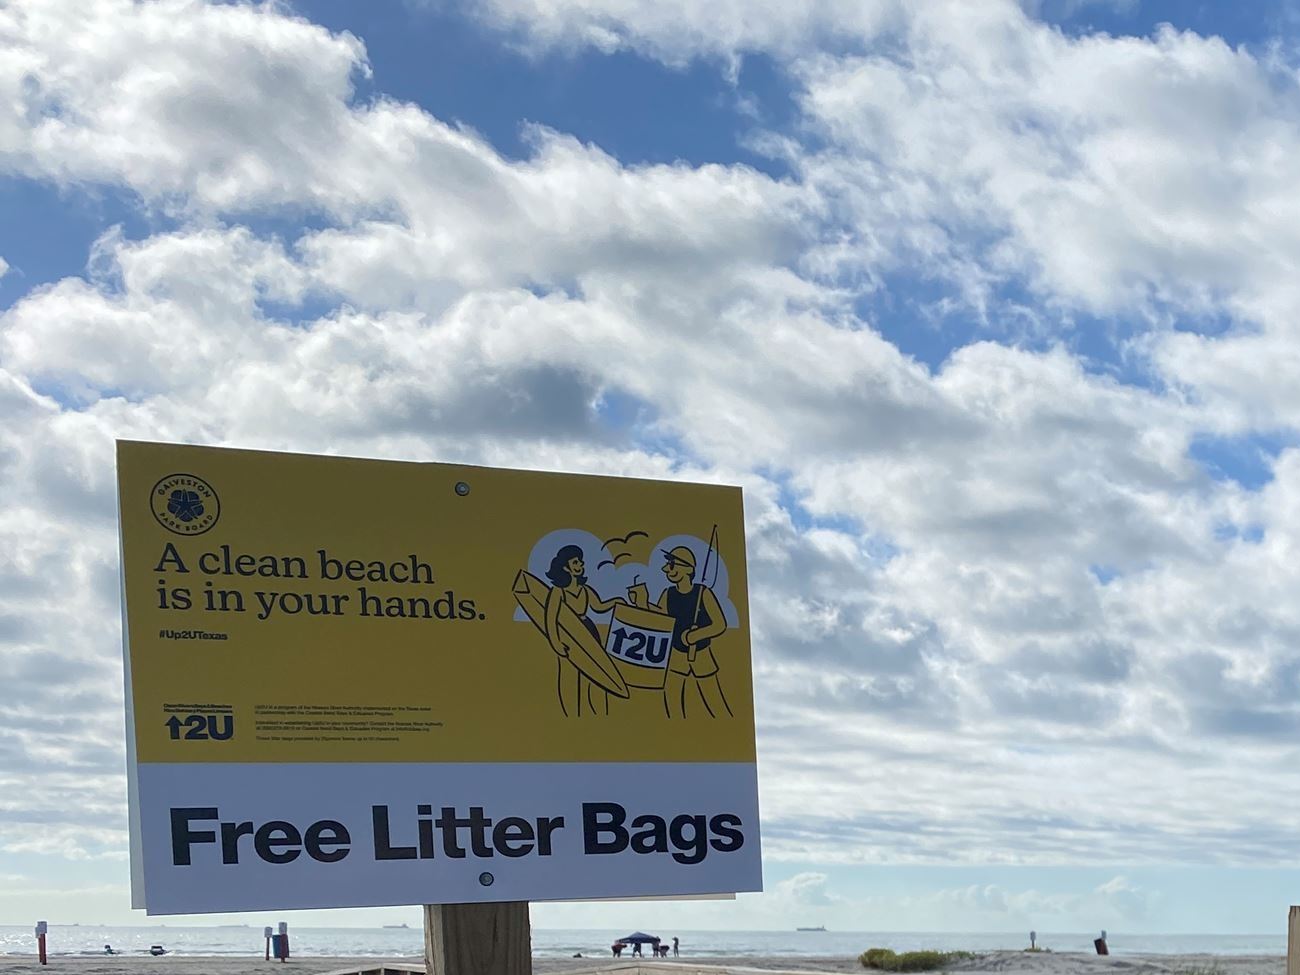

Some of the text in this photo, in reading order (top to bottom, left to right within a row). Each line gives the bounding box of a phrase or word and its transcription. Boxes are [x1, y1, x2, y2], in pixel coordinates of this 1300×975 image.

[157, 479, 212, 498] GALVESTON
[154, 542, 435, 584] A clean beach
[157, 579, 486, 621] is in your hands.
[159, 629, 228, 642] #Up2UTexas
[170, 801, 745, 866] Free Litter Bags
